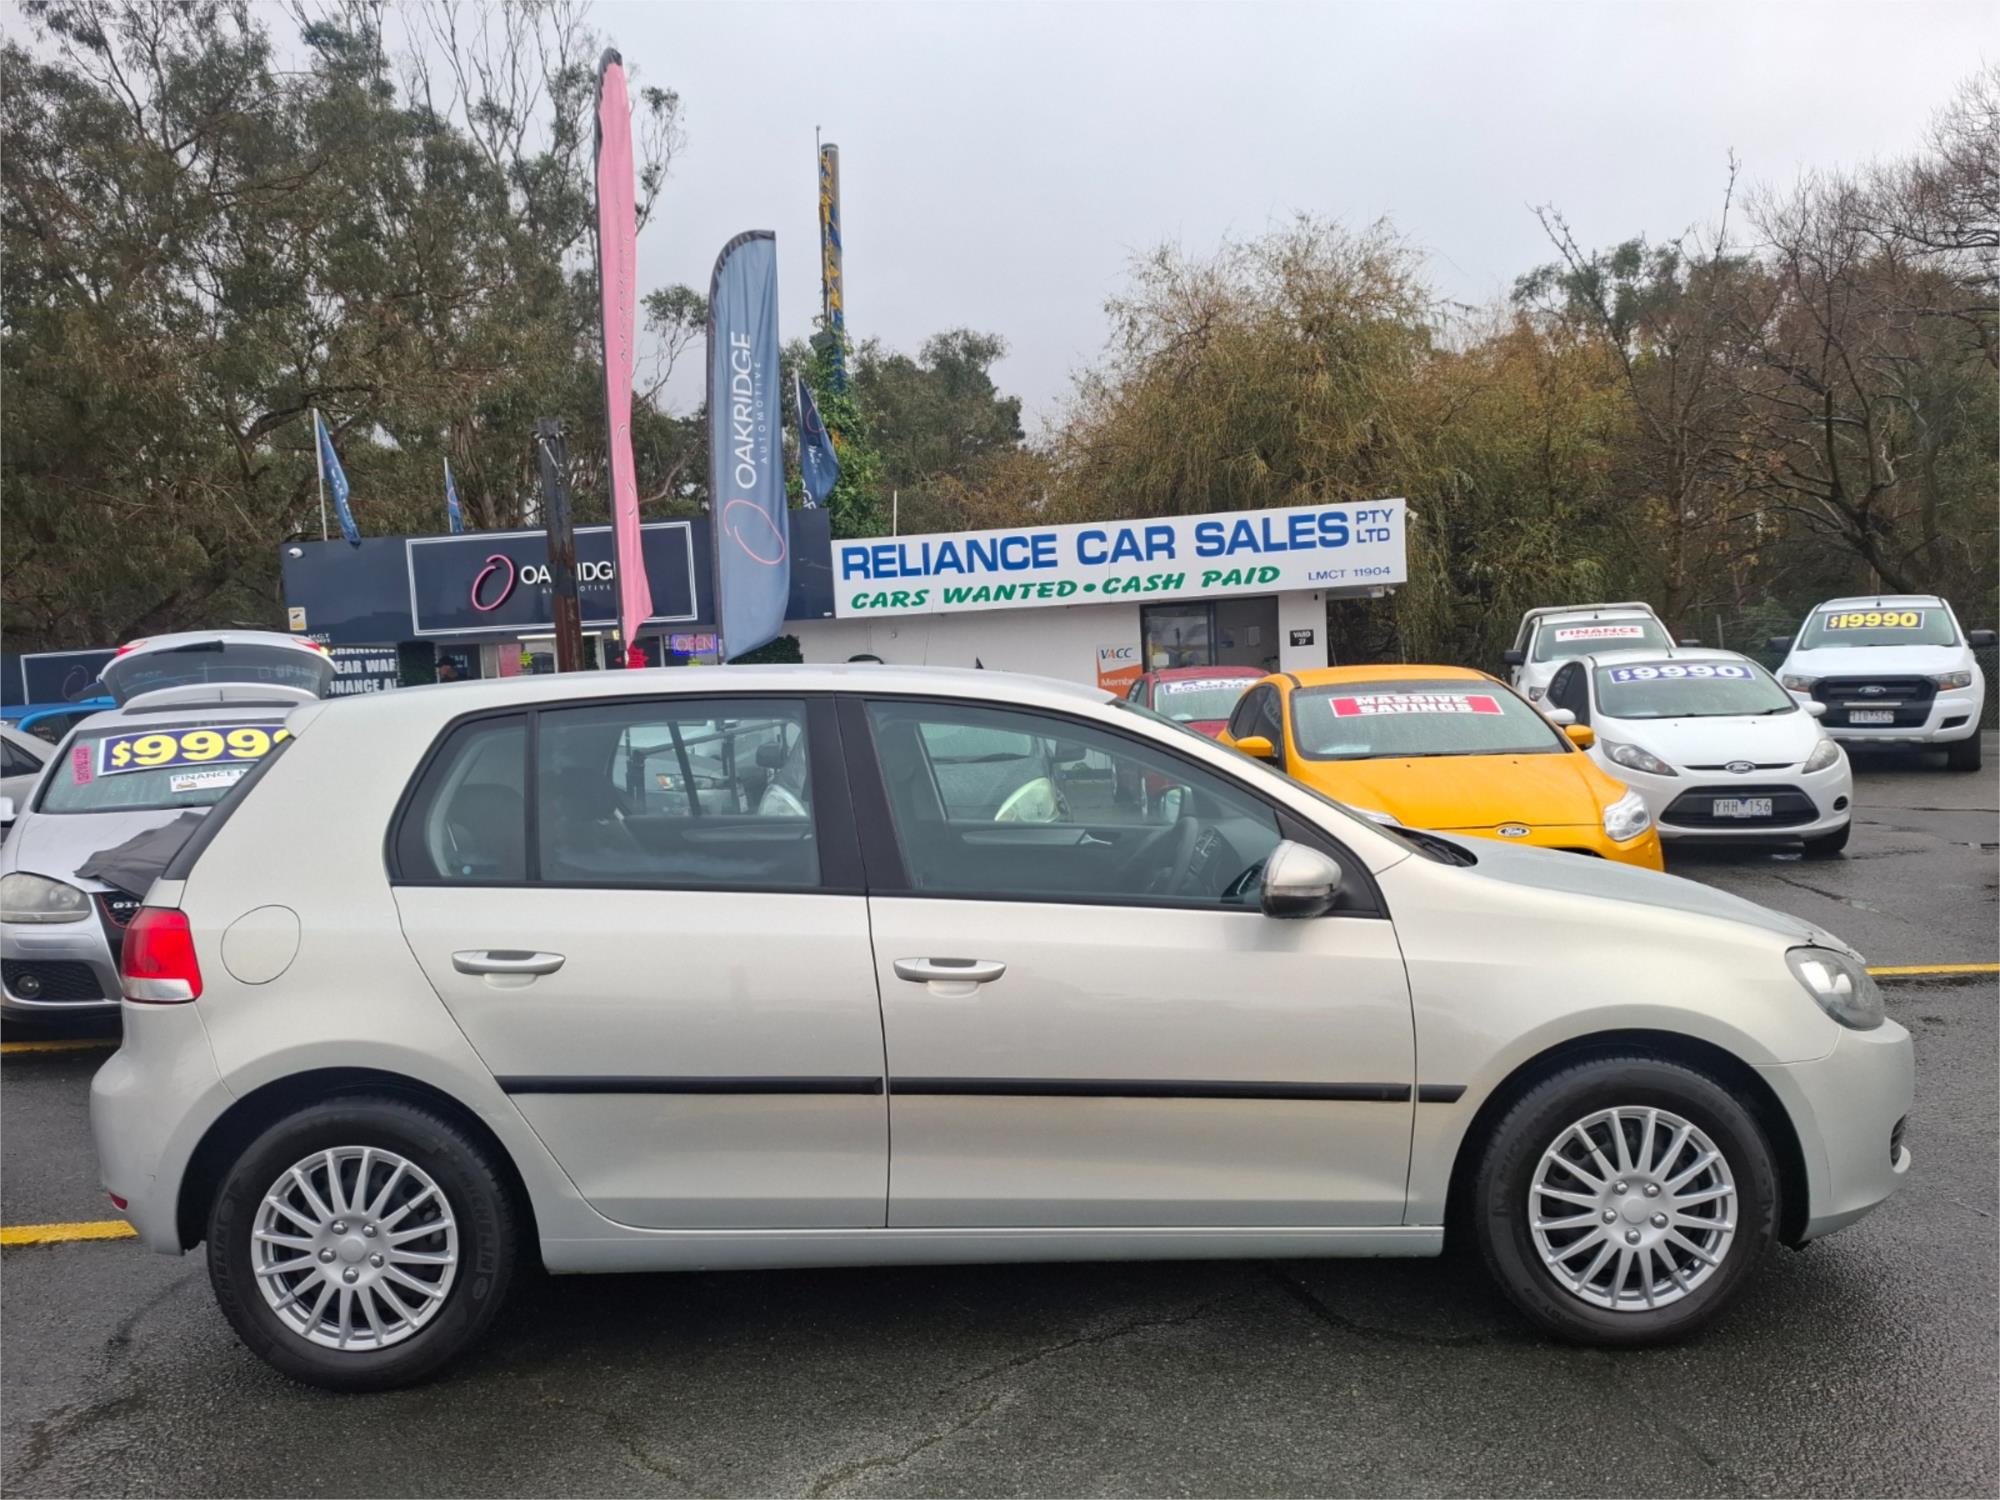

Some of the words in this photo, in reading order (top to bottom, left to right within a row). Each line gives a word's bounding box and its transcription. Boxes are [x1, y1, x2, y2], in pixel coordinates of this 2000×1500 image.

[730, 331, 757, 489] OAKRIDGE
[754, 362, 768, 465] AUTOMOTIVE
[1356, 509, 1393, 525] PTY
[1356, 528, 1391, 543] LTD
[841, 533, 1058, 580] RELIANCE
[1076, 525, 1176, 565] CAR
[1195, 511, 1349, 557] SALES
[1308, 570, 1347, 581] LMCT
[1353, 566, 1391, 577] 11904
[851, 589, 930, 609] CARS
[943, 580, 1078, 603] WANTED
[1102, 572, 1186, 594] CASH
[1201, 566, 1281, 588] PAID
[1829, 612, 1918, 628] $19990
[1560, 626, 1640, 637] FINANCE
[676, 634, 713, 651] OPEN
[1101, 647, 1133, 659] VACC
[335, 660, 362, 675] EAR
[1617, 665, 1744, 681] $9990
[326, 679, 379, 694] INANCE
[1356, 695, 1469, 705] MASSIVE
[1359, 703, 1473, 714] SAVINGS
[172, 770, 235, 782] FINANCE
[1714, 800, 1738, 813] YHH
[1749, 800, 1770, 812] 156
